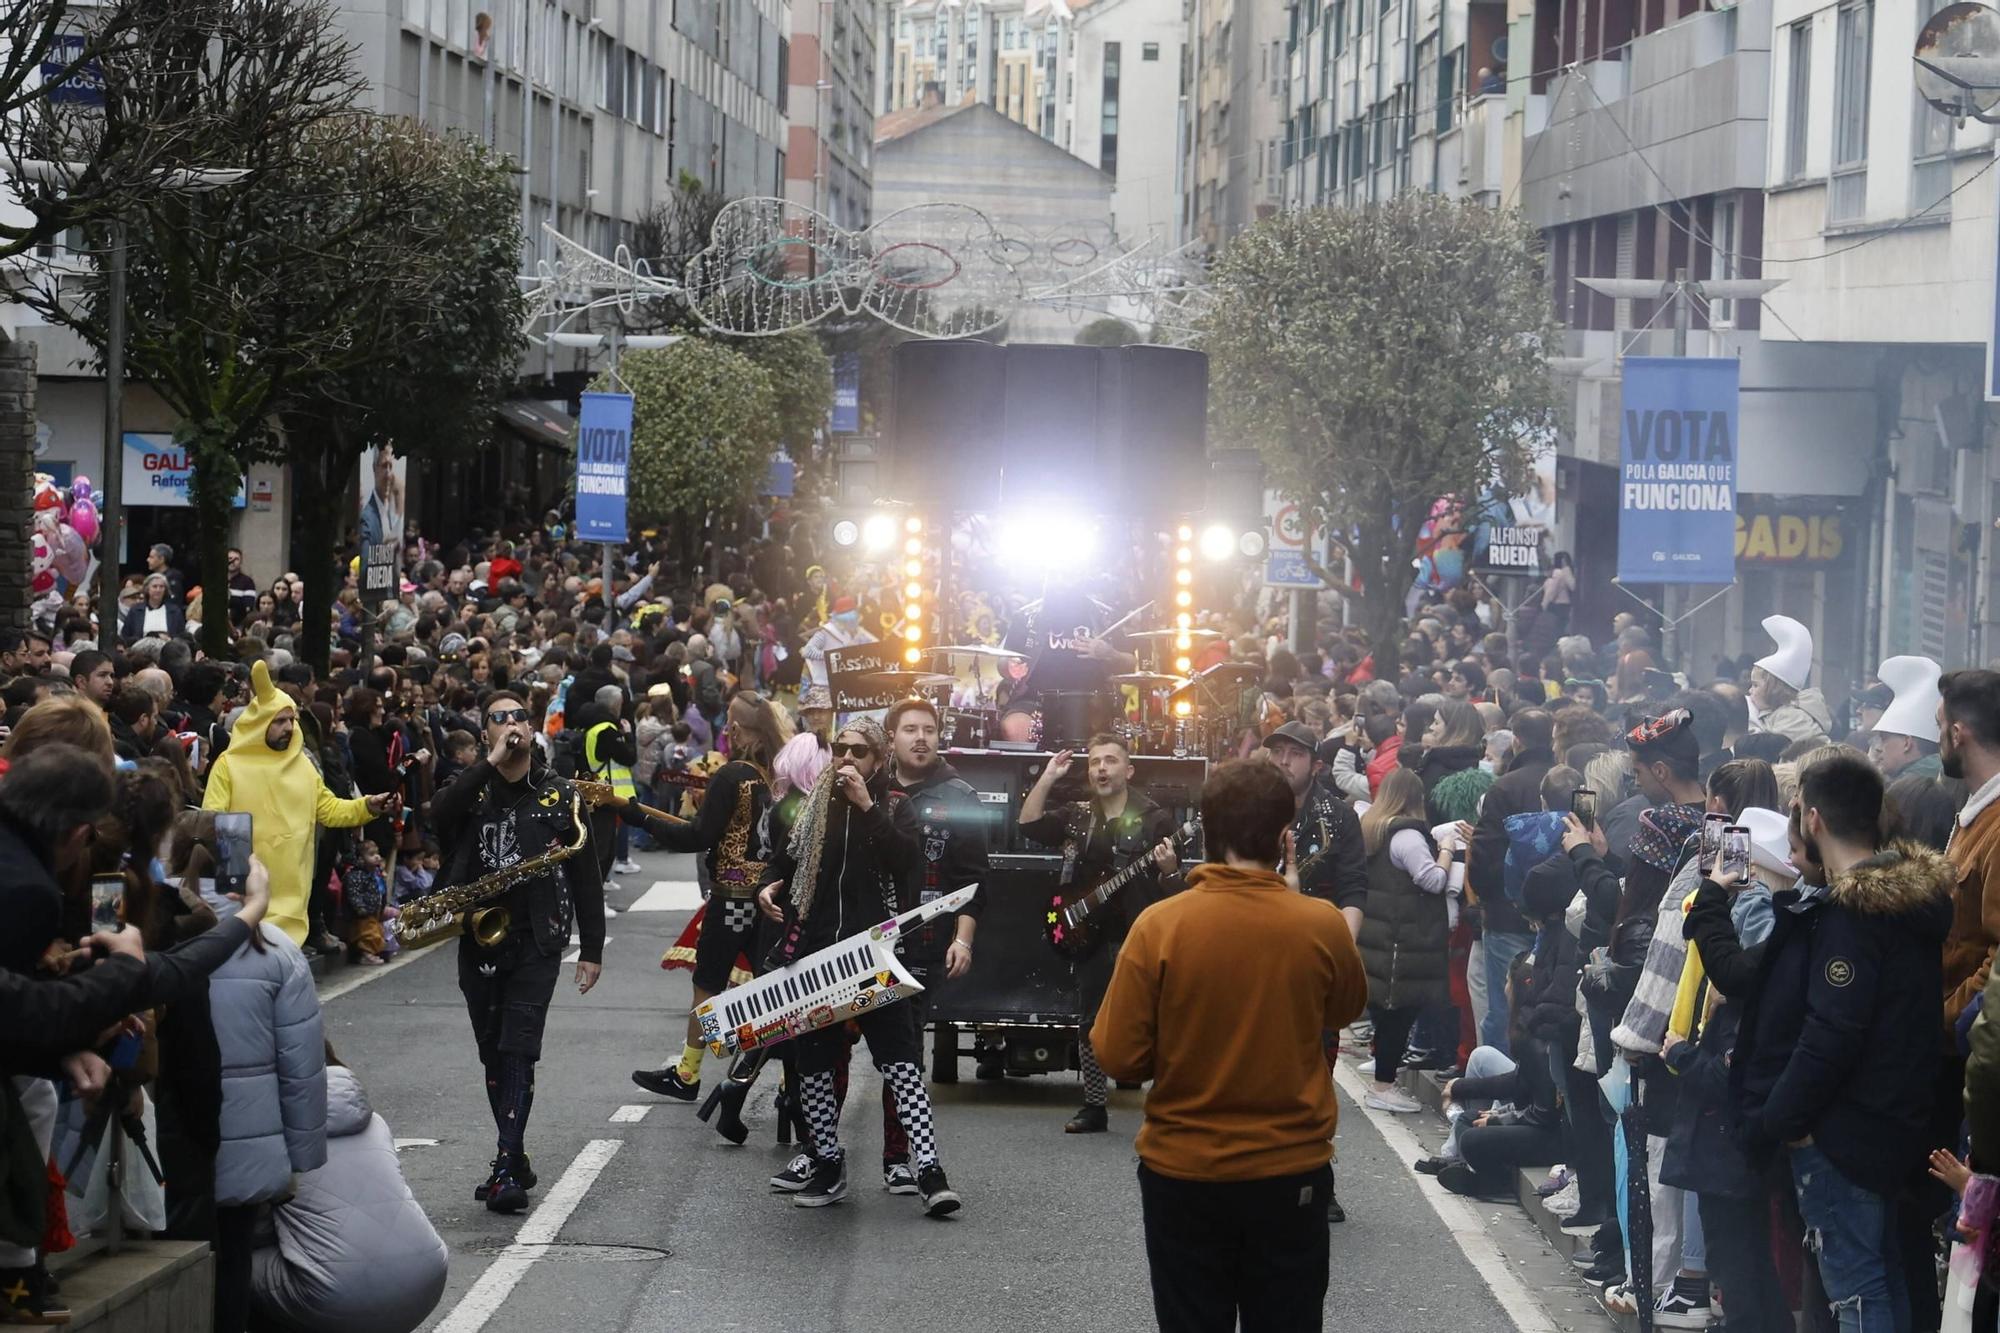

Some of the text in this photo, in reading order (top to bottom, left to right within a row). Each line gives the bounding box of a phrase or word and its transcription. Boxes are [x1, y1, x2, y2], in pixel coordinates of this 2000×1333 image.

[582, 428, 626, 461] VOTA
[1626, 409, 1733, 461] VOTA
[1626, 463, 1731, 481] POLA GALICIA QUE
[578, 475, 625, 495] FUNCIONA
[1624, 483, 1732, 511] FUNCIONA
[1489, 526, 1539, 546] ALFONSO
[1489, 544, 1539, 567] RUEDA
[702, 1016, 719, 1027] FCK
[705, 1024, 720, 1036] CPS
